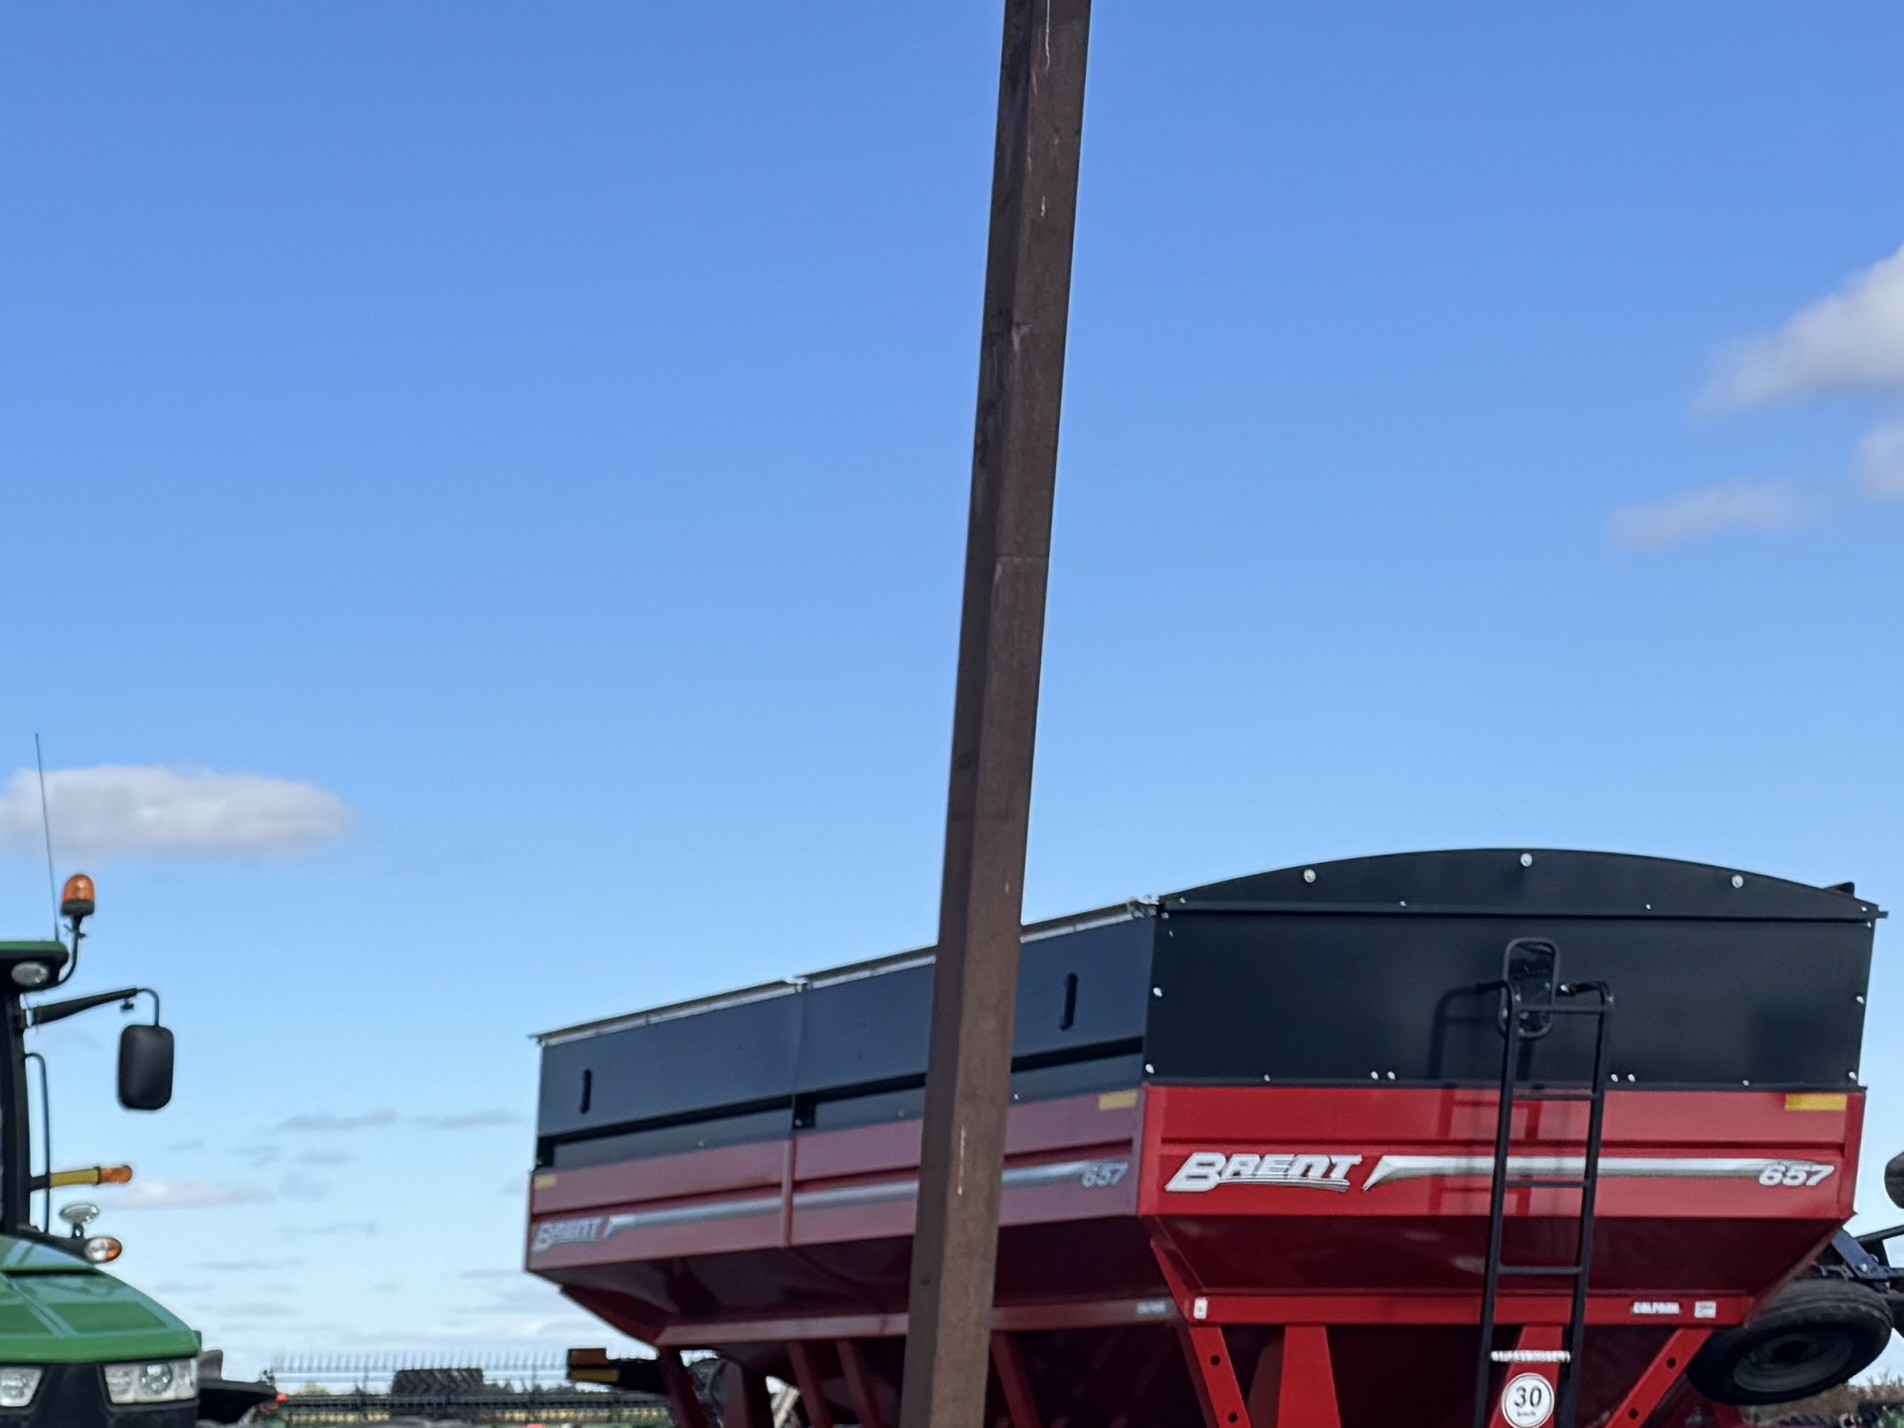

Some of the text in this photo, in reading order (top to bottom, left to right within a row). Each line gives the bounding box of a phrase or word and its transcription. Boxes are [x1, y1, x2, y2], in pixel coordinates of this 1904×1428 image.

[1164, 1152, 1362, 1192] BRENT
[1759, 1162, 1835, 1187] 657
[1514, 1386, 1542, 1408] 30
